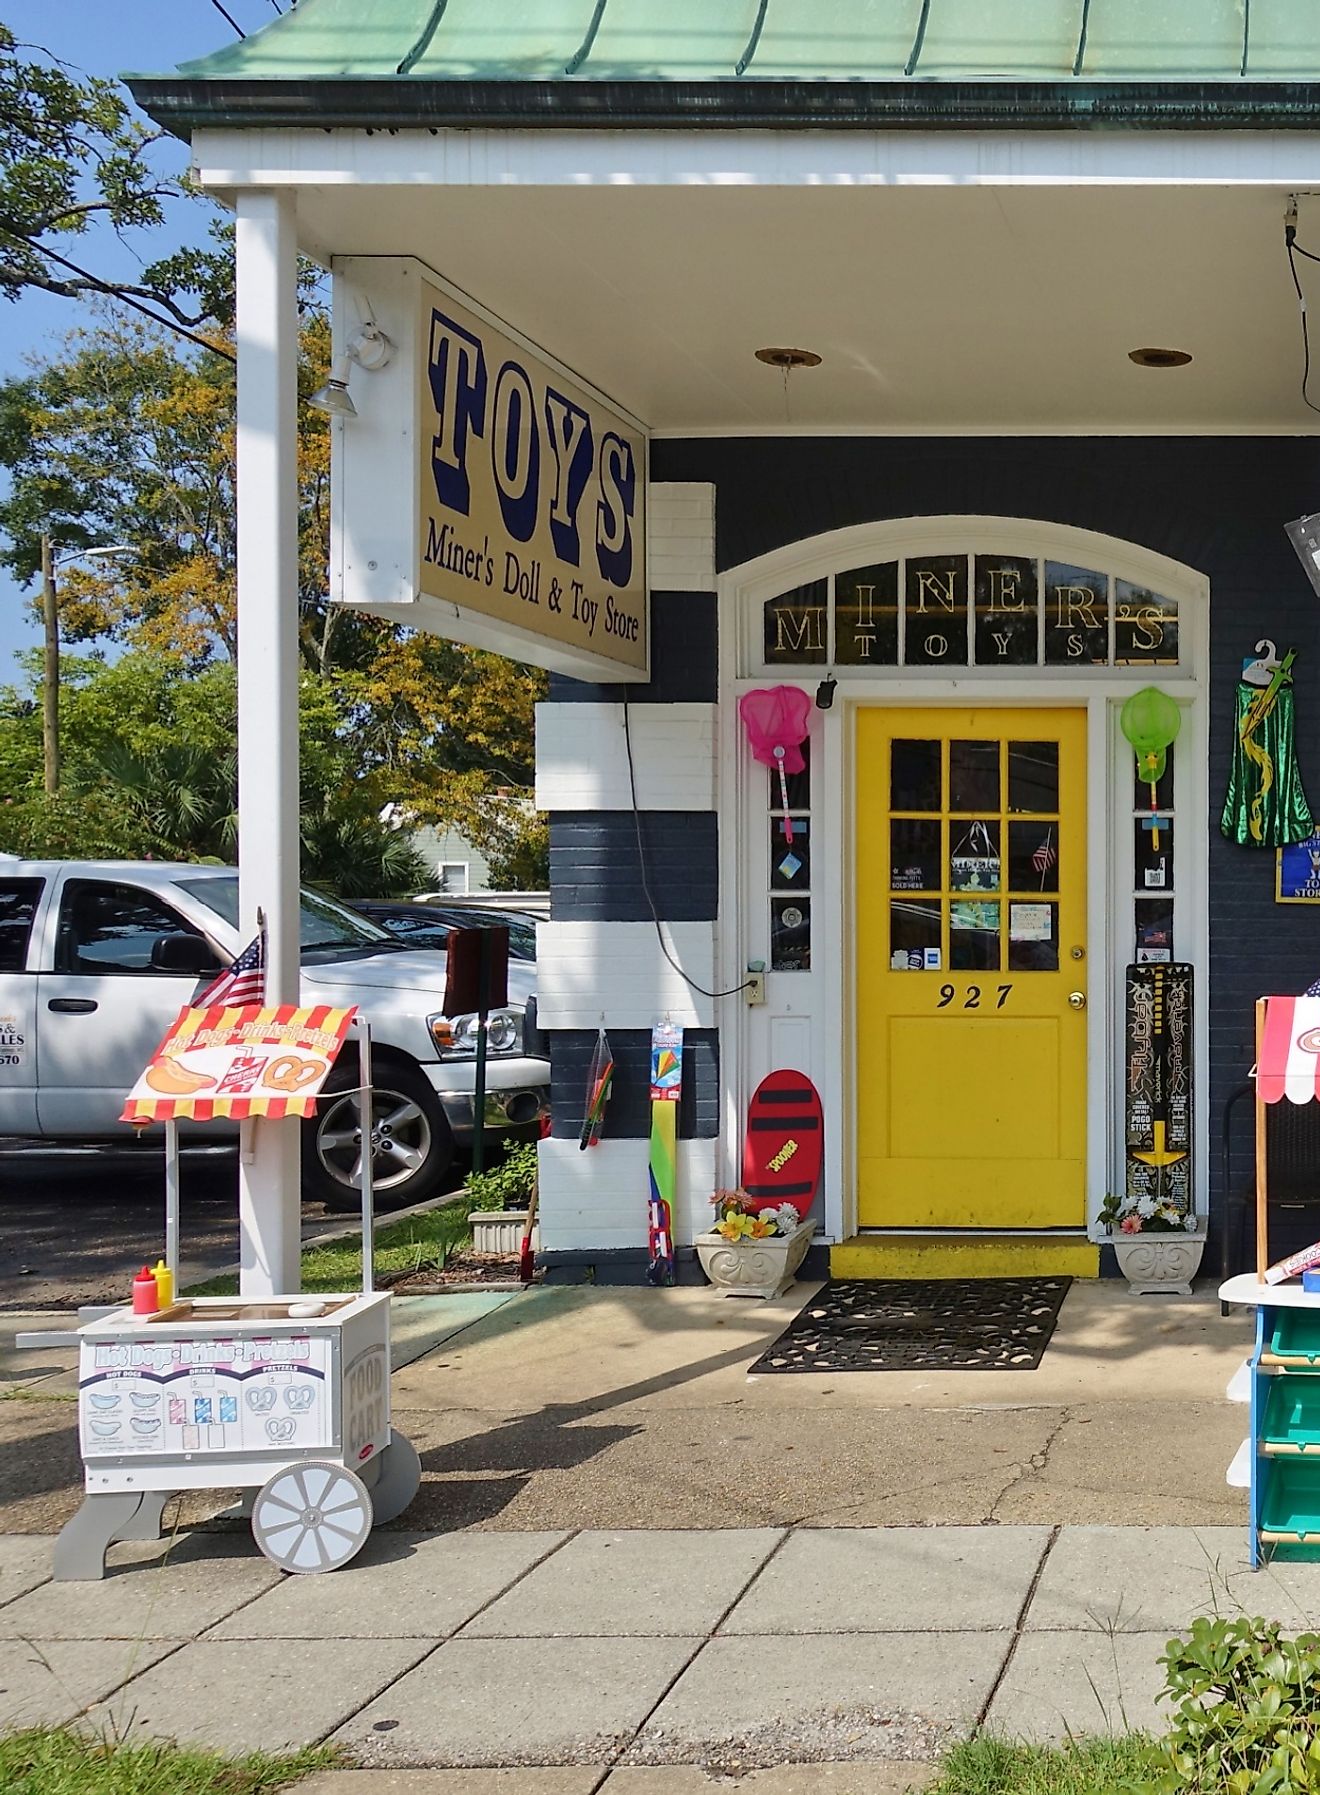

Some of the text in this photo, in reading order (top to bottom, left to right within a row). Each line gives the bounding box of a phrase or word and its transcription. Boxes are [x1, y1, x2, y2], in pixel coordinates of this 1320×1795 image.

[428, 307, 635, 588] TOYS
[424, 517, 639, 642] Miner's Doll & Toy Store
[773, 569, 1165, 651] MINER'S
[854, 634, 1084, 658] TOYS
[937, 984, 1013, 1009] 927
[0, 1034, 24, 1046] LES
[160, 1022, 340, 1056] Hot Dogs Drinks Pretzels
[1130, 1123, 1151, 1132] STICK
[1131, 1115, 1151, 1123] POGO
[95, 1341, 310, 1370] Hot Dogs Drinks Pretzels
[262, 1365, 298, 1373] PRETZELS
[349, 1359, 382, 1411] FOOD
